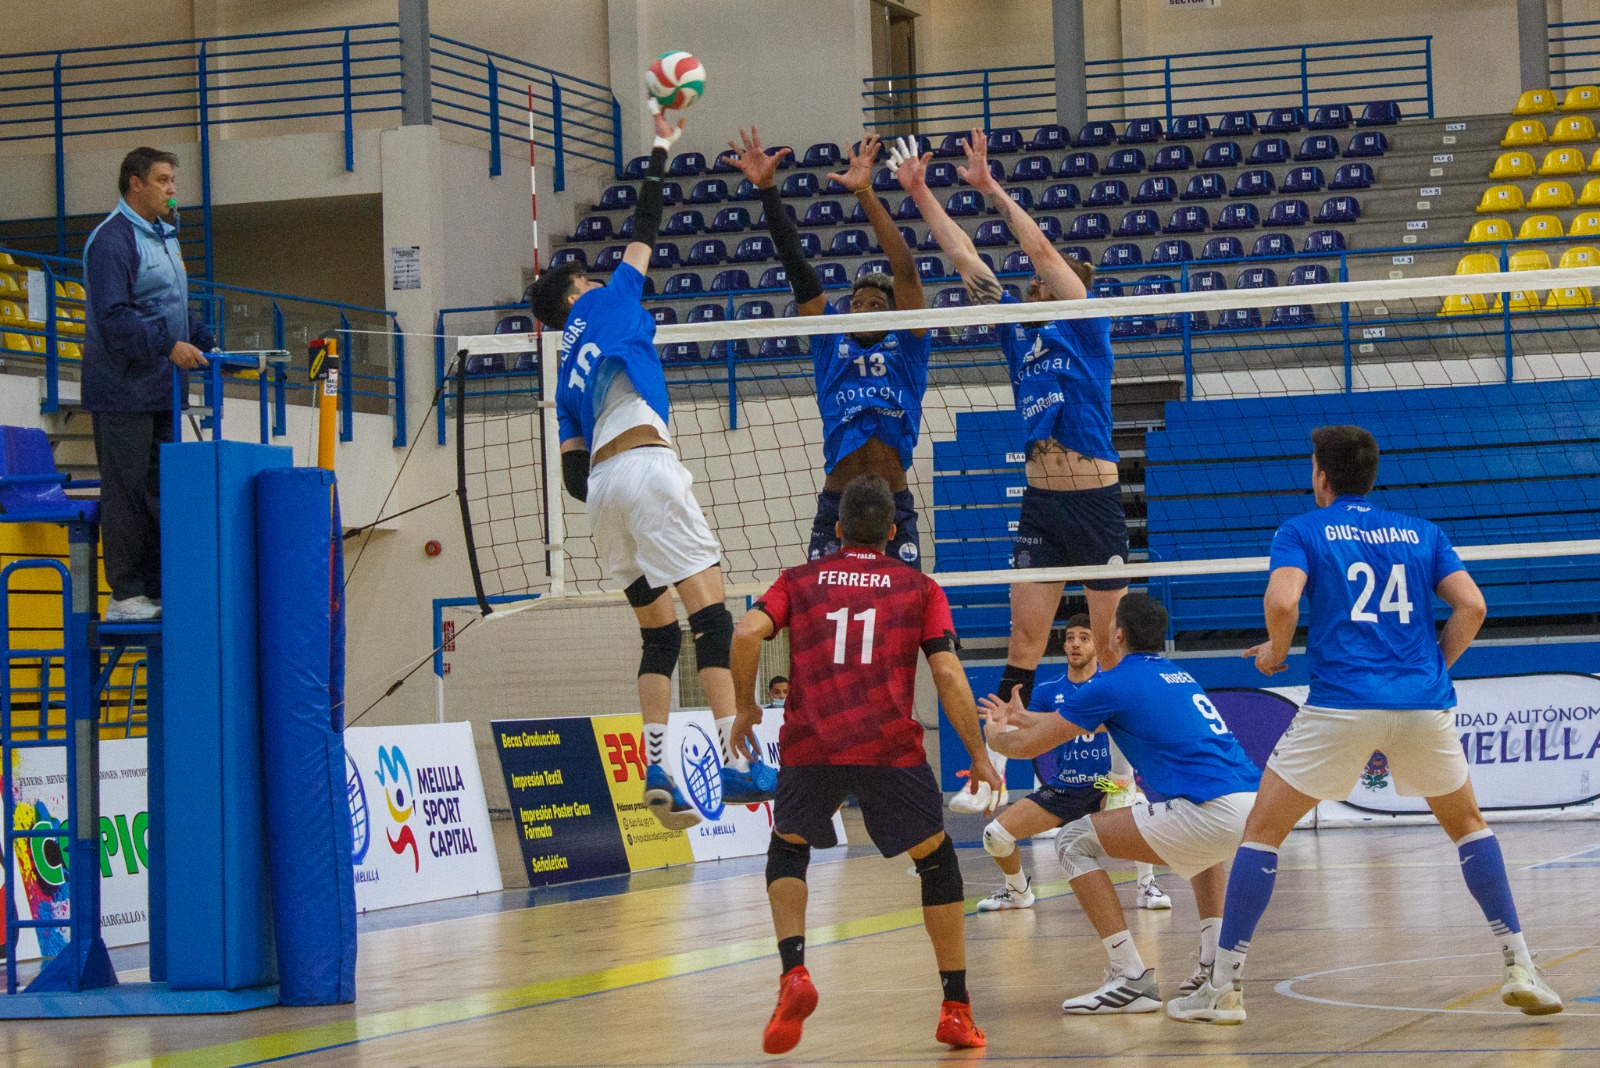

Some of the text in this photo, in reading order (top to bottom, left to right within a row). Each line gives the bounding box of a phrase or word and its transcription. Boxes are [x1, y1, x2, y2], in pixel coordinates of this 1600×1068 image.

[853, 352, 887, 377] 13
[1324, 524, 1419, 544] GIUSTINIANO
[818, 570, 891, 588] FERRERA
[1347, 561, 1413, 624] 24
[826, 607, 877, 664] 11
[1192, 693, 1228, 735] 9
[501, 730, 560, 748] Becas Graduación
[416, 765, 465, 794] MELILLA
[511, 769, 563, 792] Impresión Textil
[422, 797, 462, 826] SPORT
[520, 801, 591, 826] Impresión Poster Gran
[429, 827, 477, 858] CAPITAL
[524, 822, 552, 840] Formato
[532, 853, 568, 873] Señalética
[140, 910, 147, 921] 8
